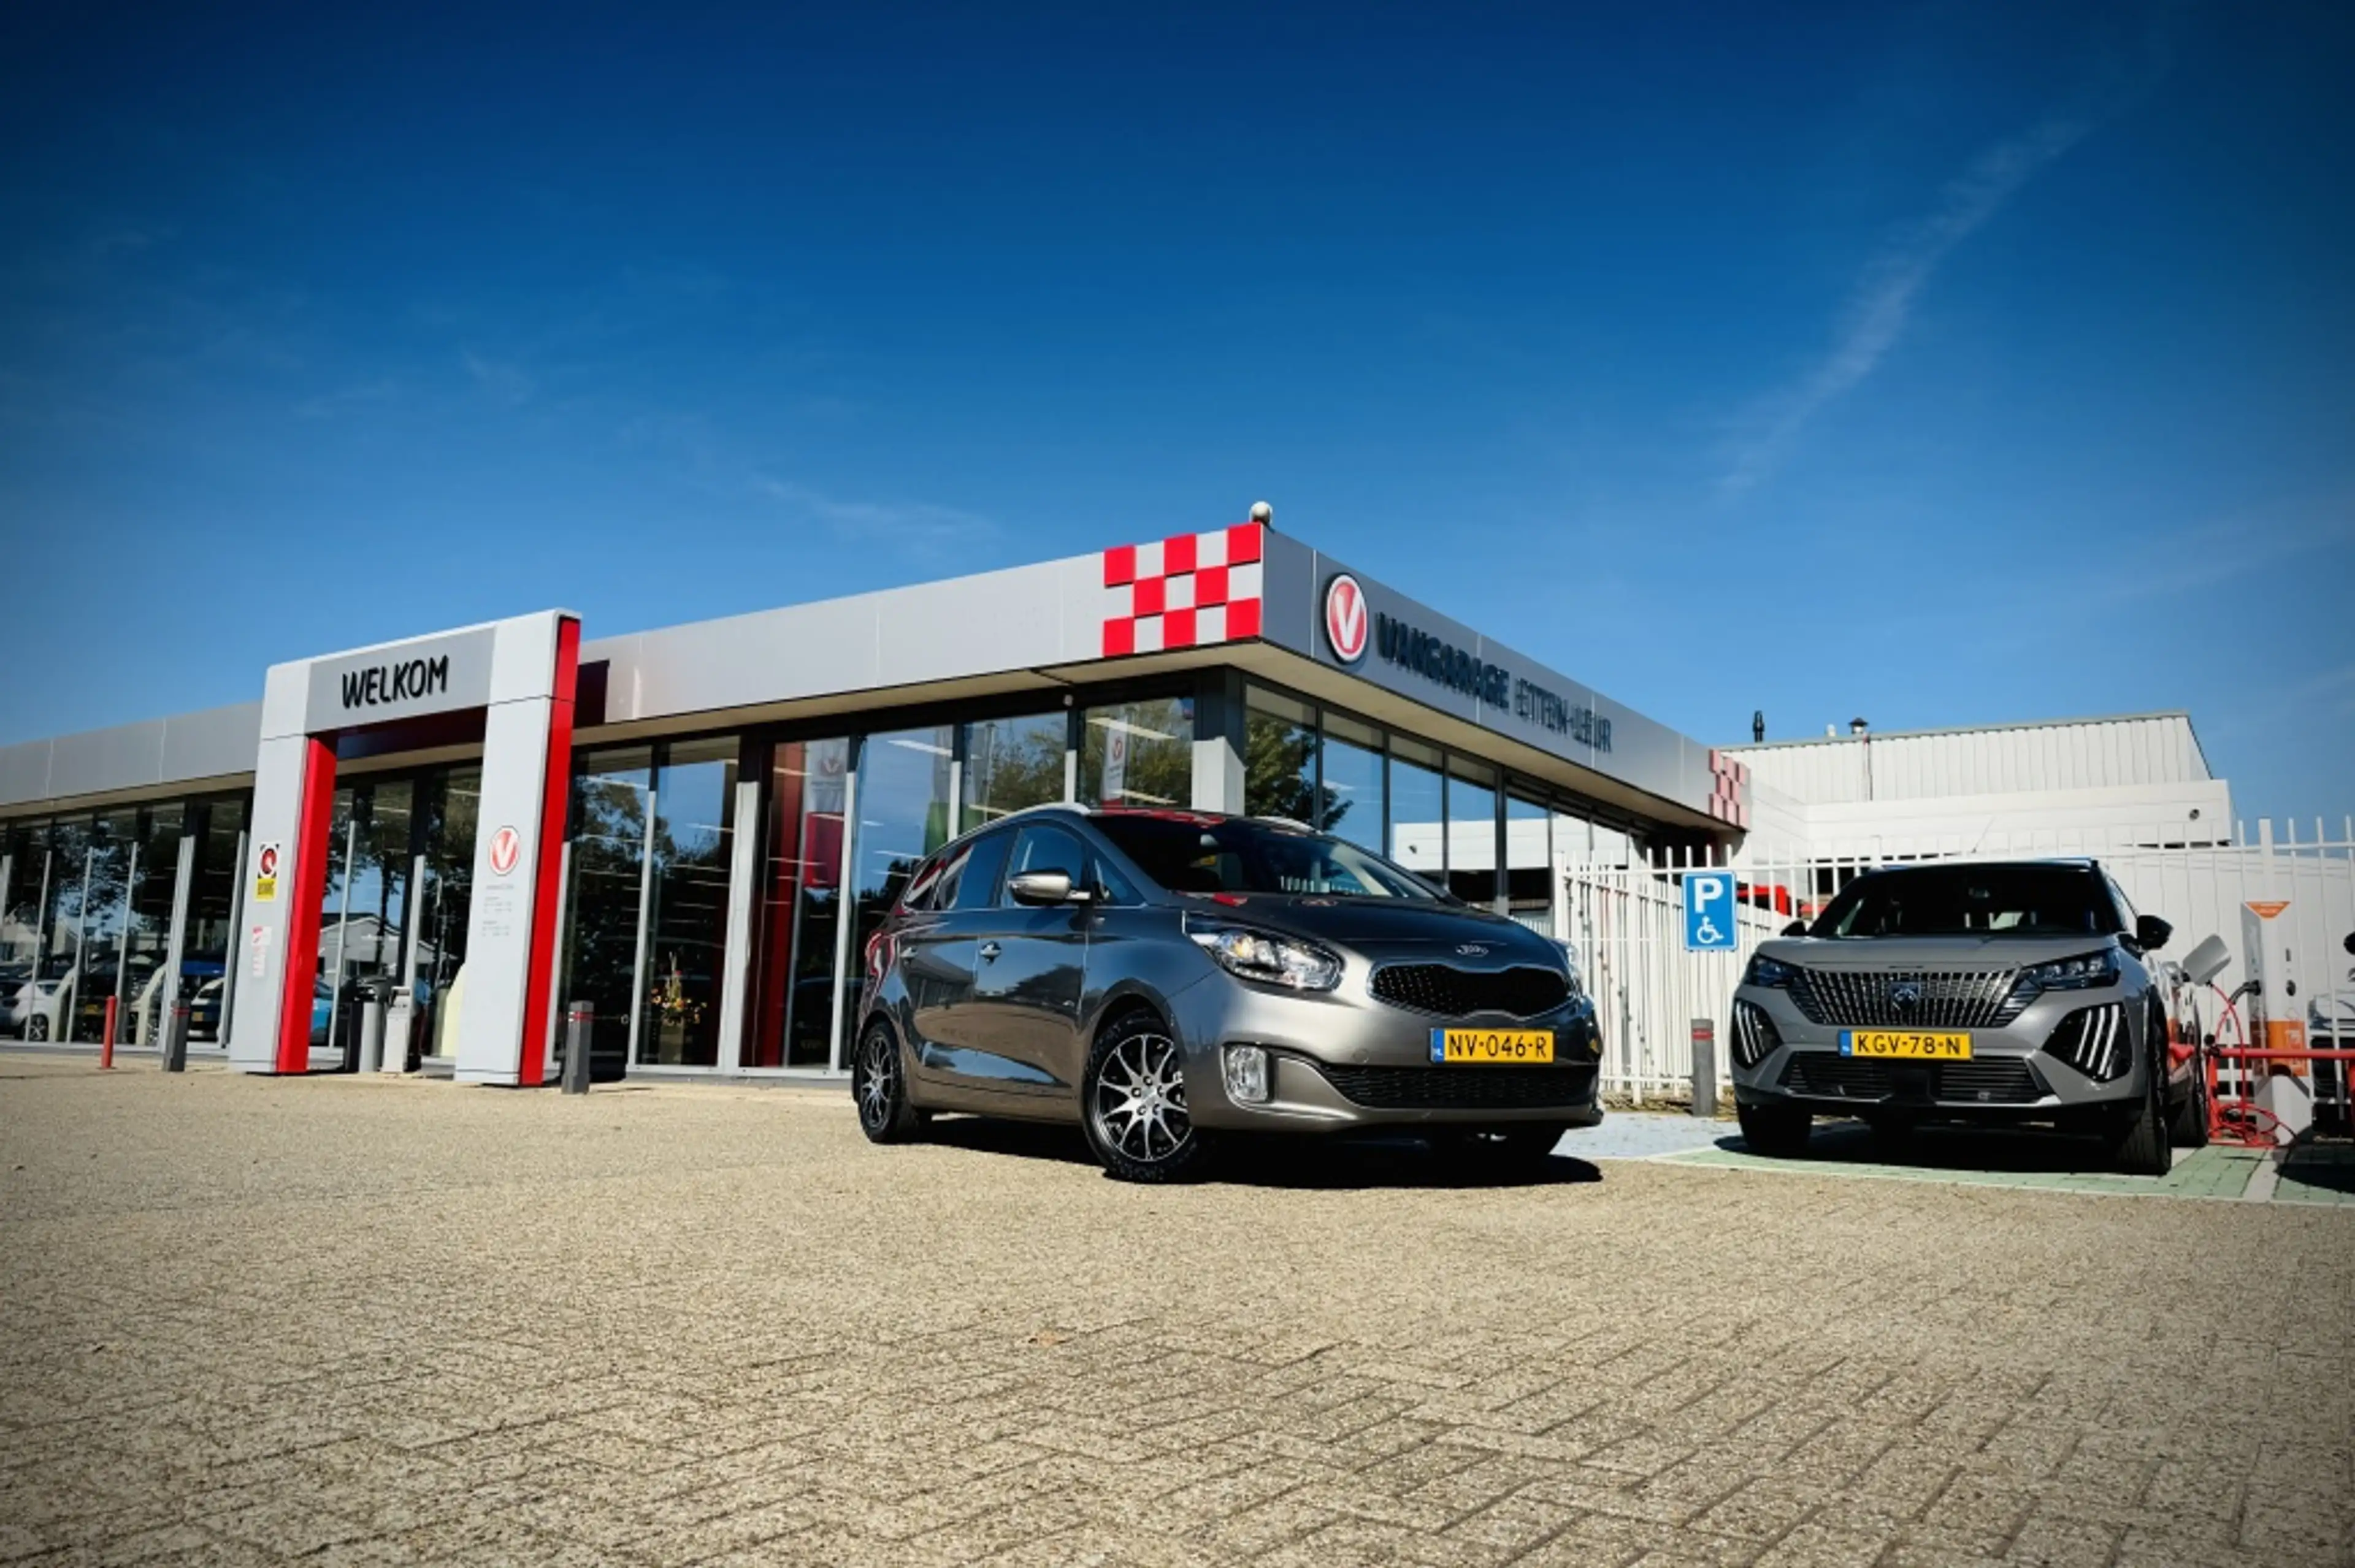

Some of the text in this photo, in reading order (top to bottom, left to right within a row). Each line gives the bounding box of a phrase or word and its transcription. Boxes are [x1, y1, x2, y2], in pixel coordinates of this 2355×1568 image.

[342, 653, 450, 709] WELKOM
[1694, 878, 1724, 914] P
[1449, 1033, 1547, 1058] NV-046-R
[1857, 1034, 1961, 1055] KGV-78-N
